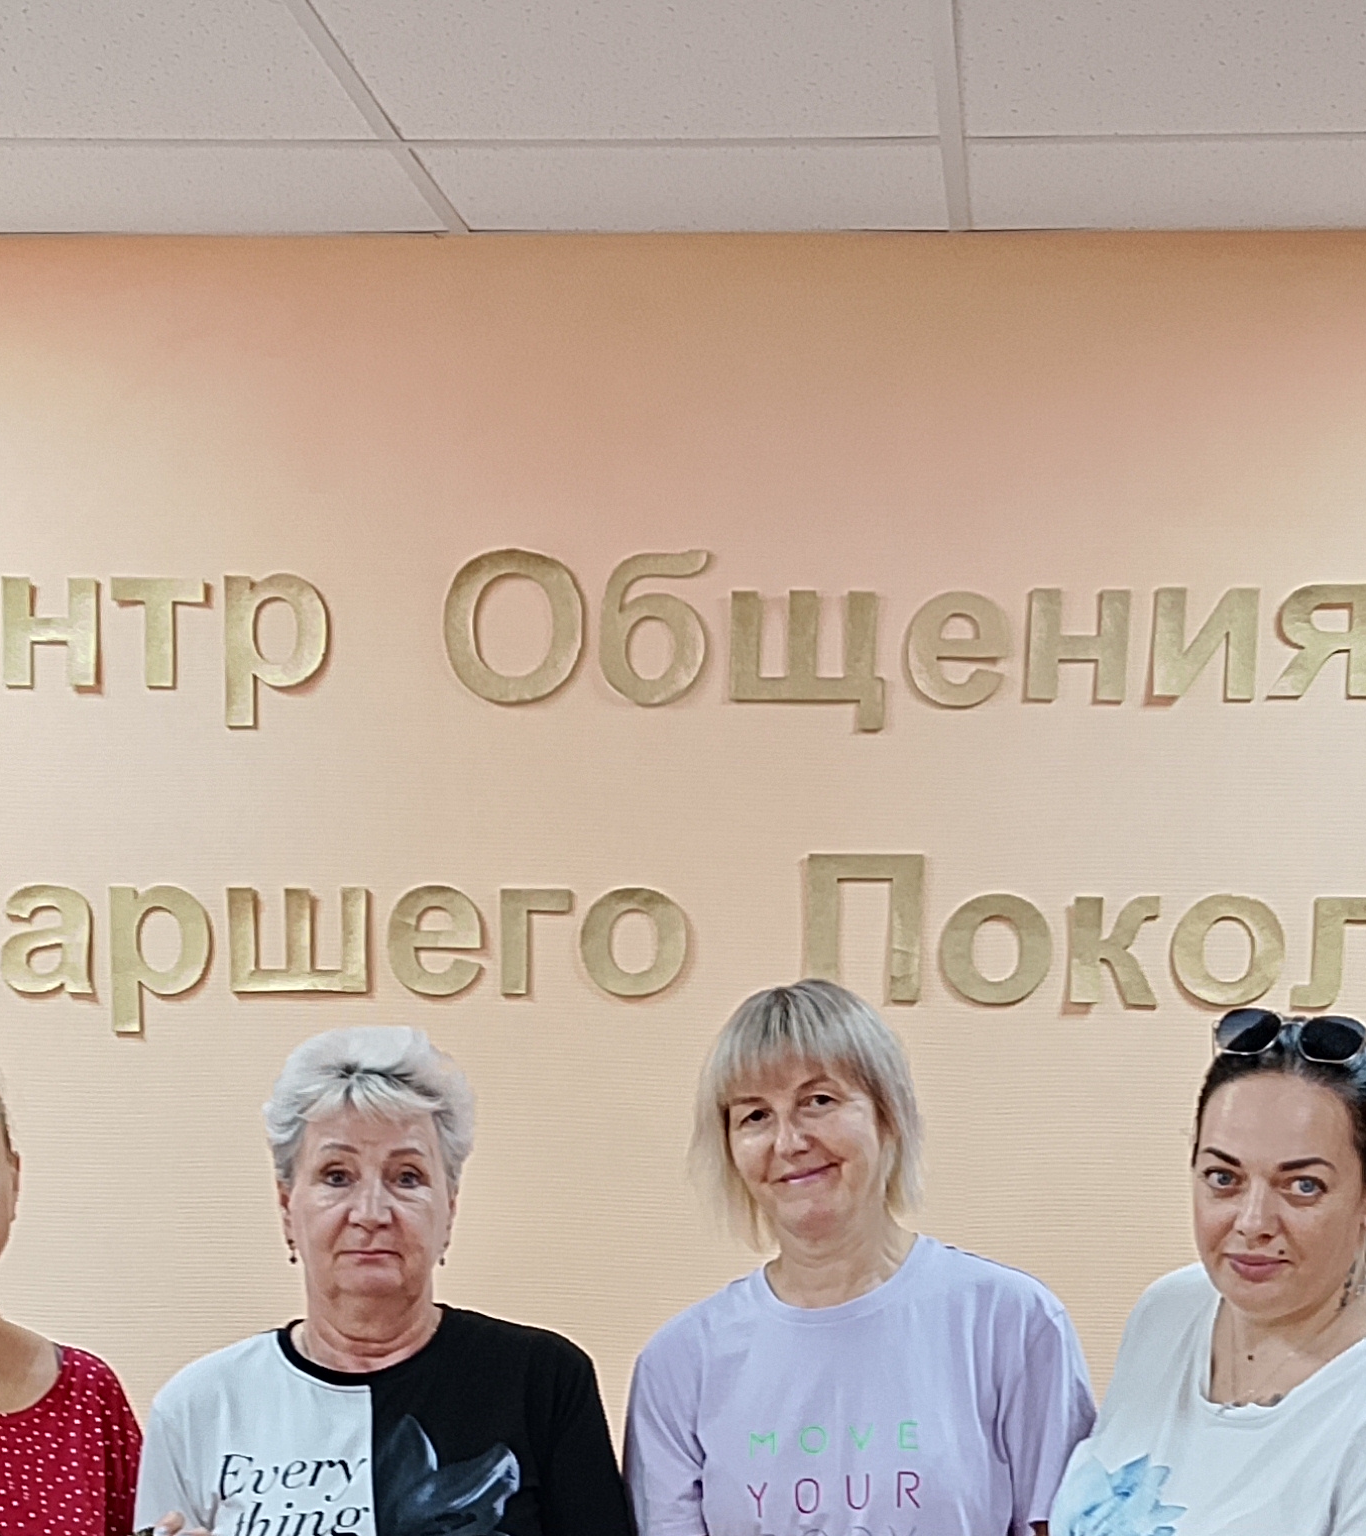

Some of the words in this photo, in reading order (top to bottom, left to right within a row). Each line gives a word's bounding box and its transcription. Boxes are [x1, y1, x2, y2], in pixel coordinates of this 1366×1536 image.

[748, 1419, 920, 1459] MOVE
[219, 1453, 368, 1502] Every
[746, 1470, 921, 1519] YOUR
